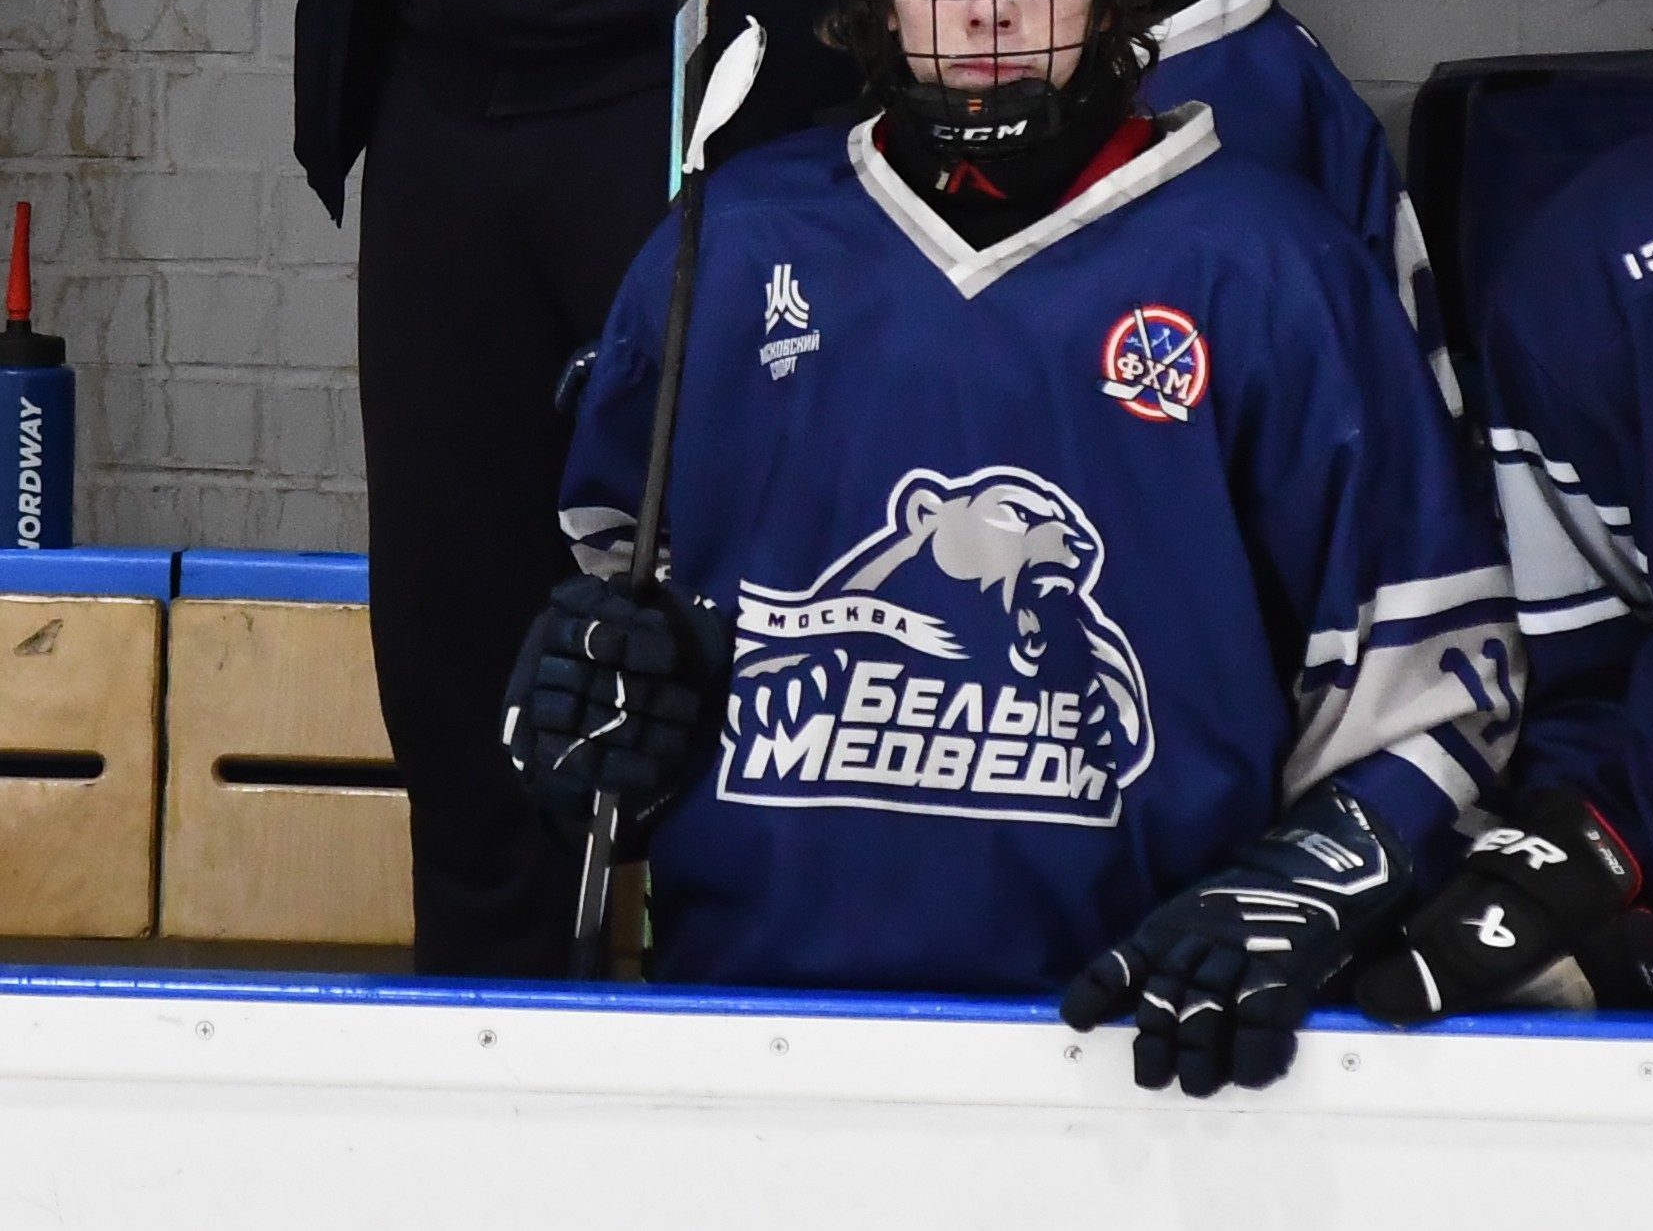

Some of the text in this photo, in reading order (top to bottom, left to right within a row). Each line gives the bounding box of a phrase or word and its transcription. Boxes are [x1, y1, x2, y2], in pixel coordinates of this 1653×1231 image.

[932, 119, 1028, 141] CCM
[1116, 352, 1193, 400] ФХМ
[767, 605, 909, 635] МОСКВА
[840, 660, 1083, 741] БЕЛЫЕ
[742, 714, 1109, 801] МЕДВЕДИ
